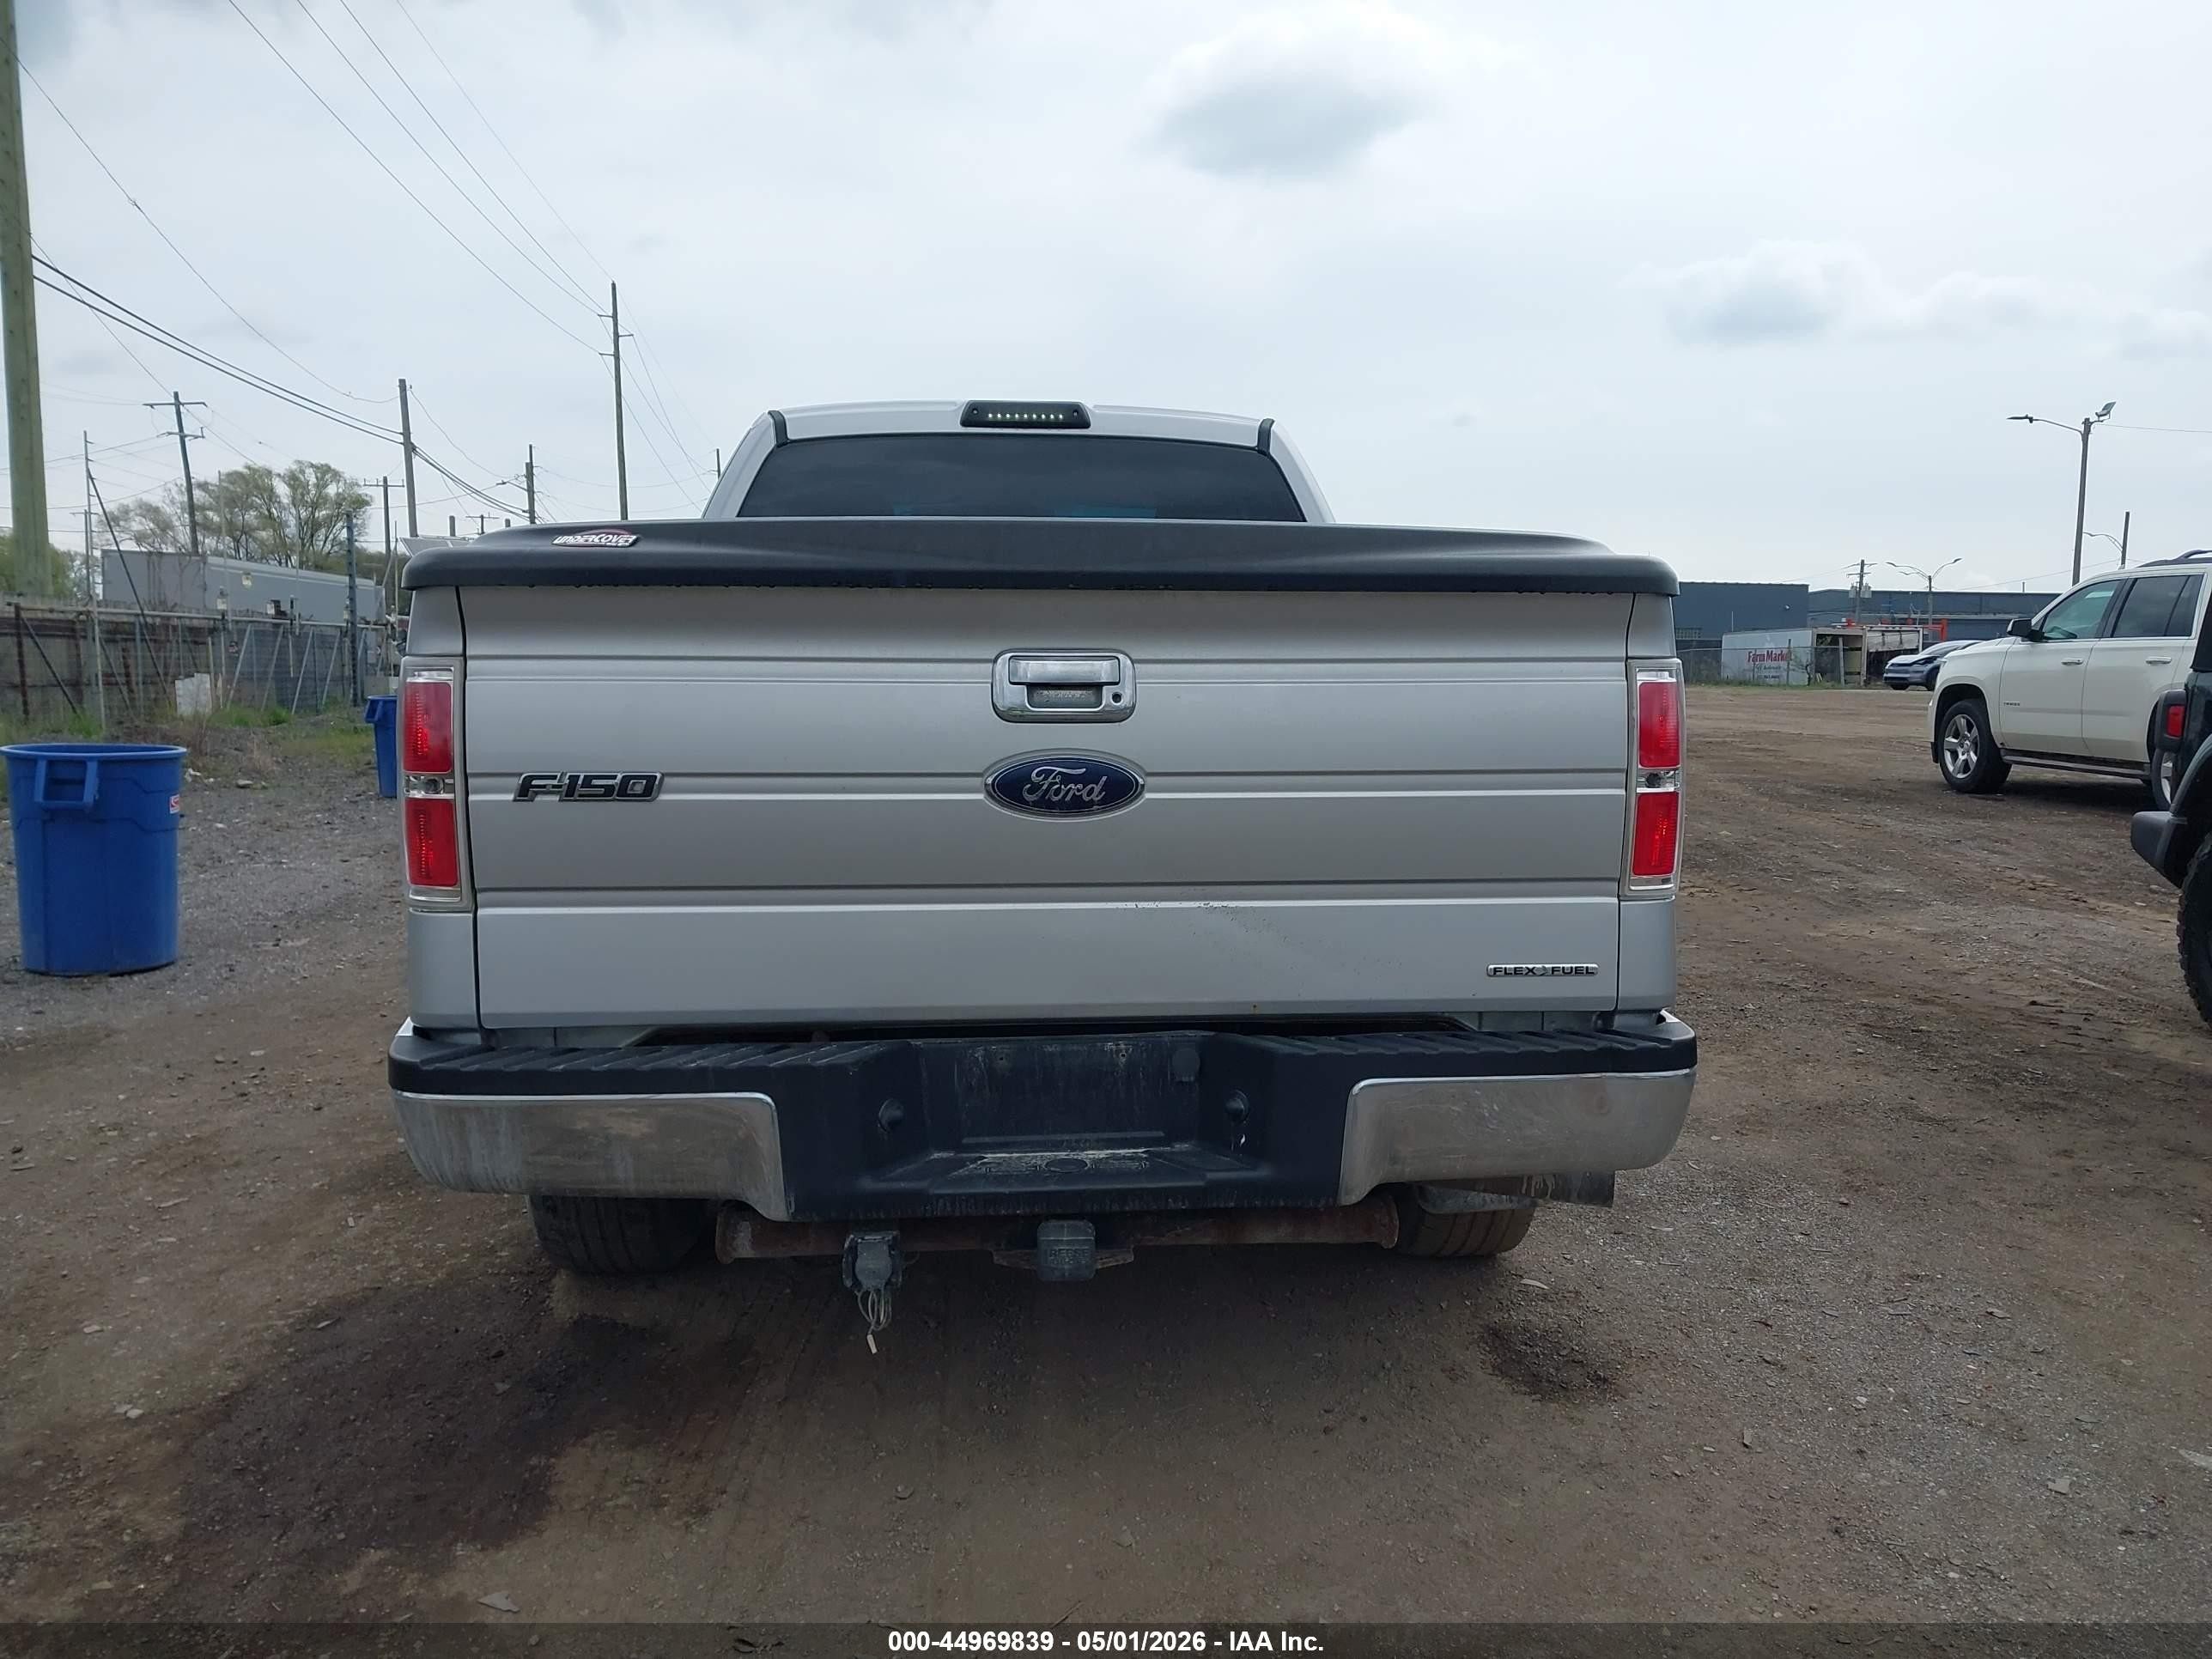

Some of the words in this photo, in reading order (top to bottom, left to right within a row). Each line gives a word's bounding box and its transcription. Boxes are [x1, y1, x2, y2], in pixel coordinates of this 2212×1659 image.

[1747, 651, 1765, 663] Farm
[514, 772, 665, 802] F-150
[1023, 766, 1108, 801] Ford
[1493, 966, 1537, 975] FLEX
[1551, 965, 1595, 975] FUEL
